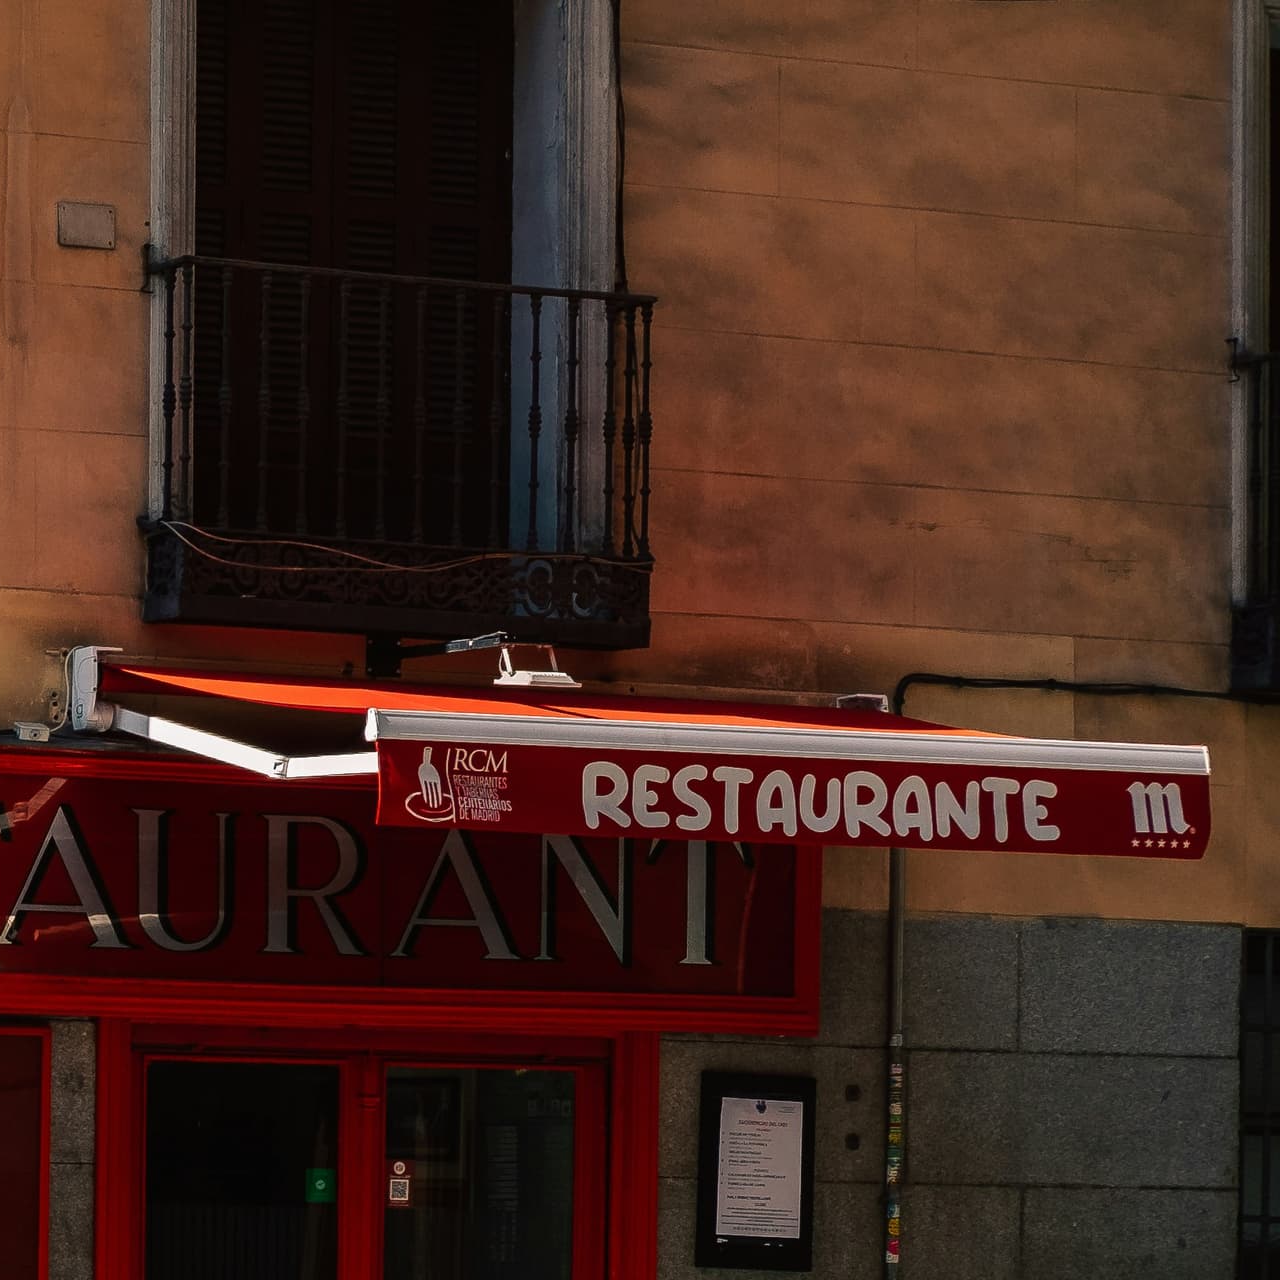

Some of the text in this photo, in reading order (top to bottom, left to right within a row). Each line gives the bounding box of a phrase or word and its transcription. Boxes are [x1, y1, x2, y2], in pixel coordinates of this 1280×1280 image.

[452, 747, 509, 774] RCM
[452, 774, 508, 790] RESTAURANTES
[458, 796, 513, 812] CENTENARIOS
[581, 760, 1062, 843] RESTAURANTE
[459, 807, 501, 822] DE MADRID
